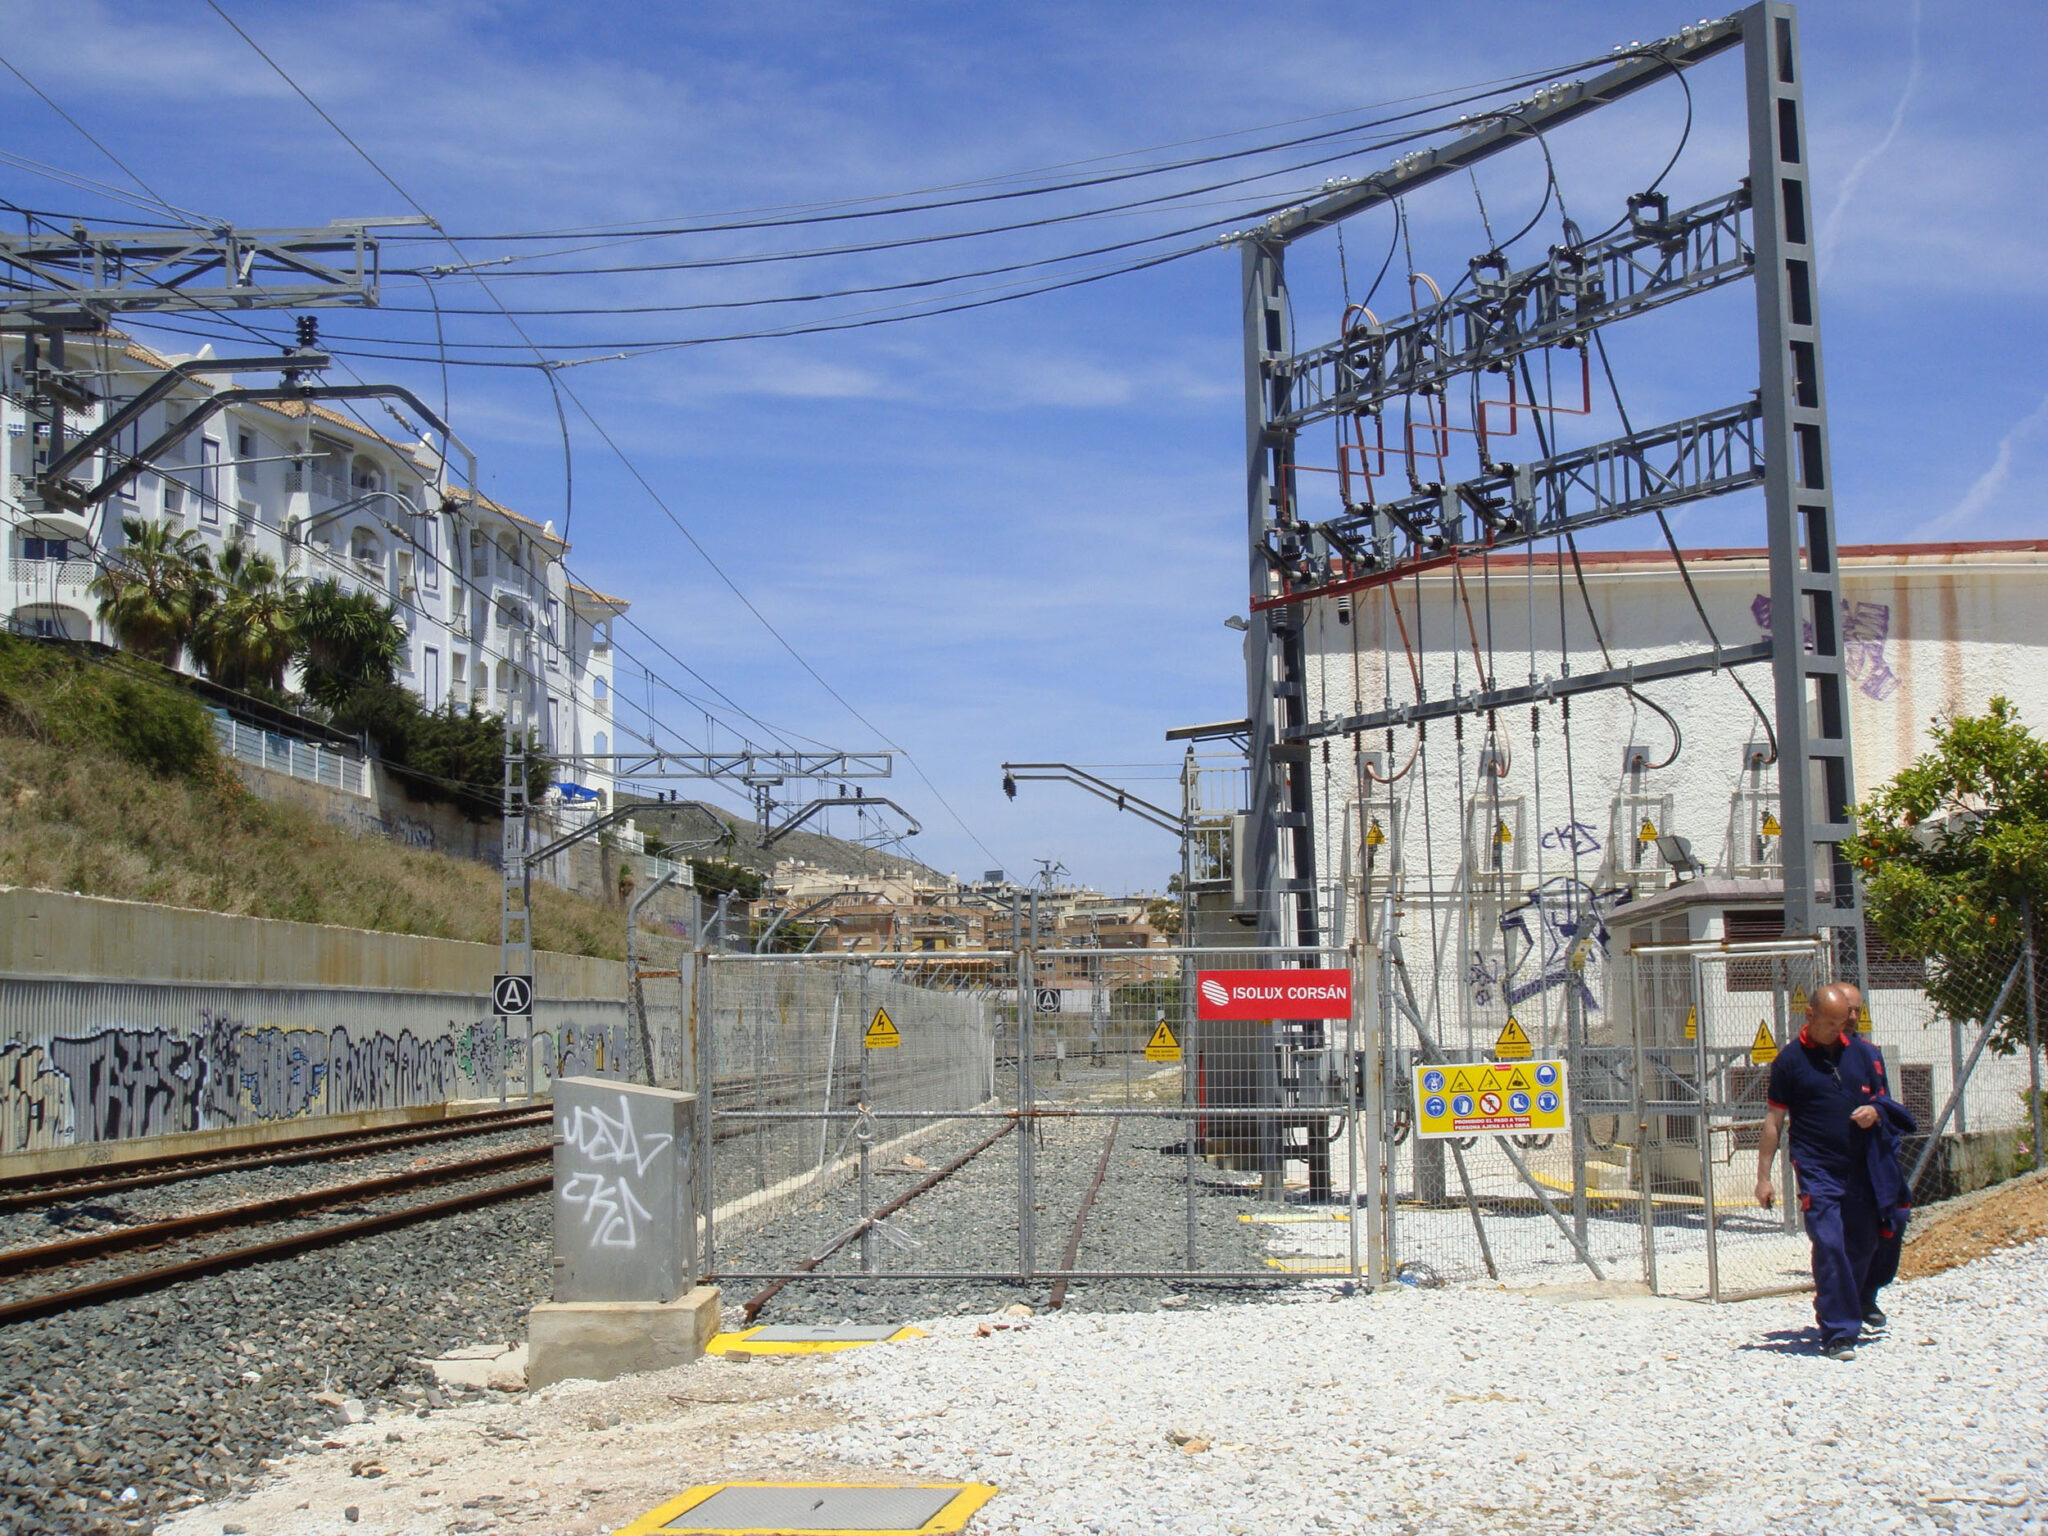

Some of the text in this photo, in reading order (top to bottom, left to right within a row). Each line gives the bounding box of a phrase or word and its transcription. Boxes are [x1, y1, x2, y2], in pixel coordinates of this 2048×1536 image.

[502, 980, 523, 1007] A
[1042, 991, 1055, 1008] A
[1232, 984, 1347, 1000] ISOLUX CORSÁN
